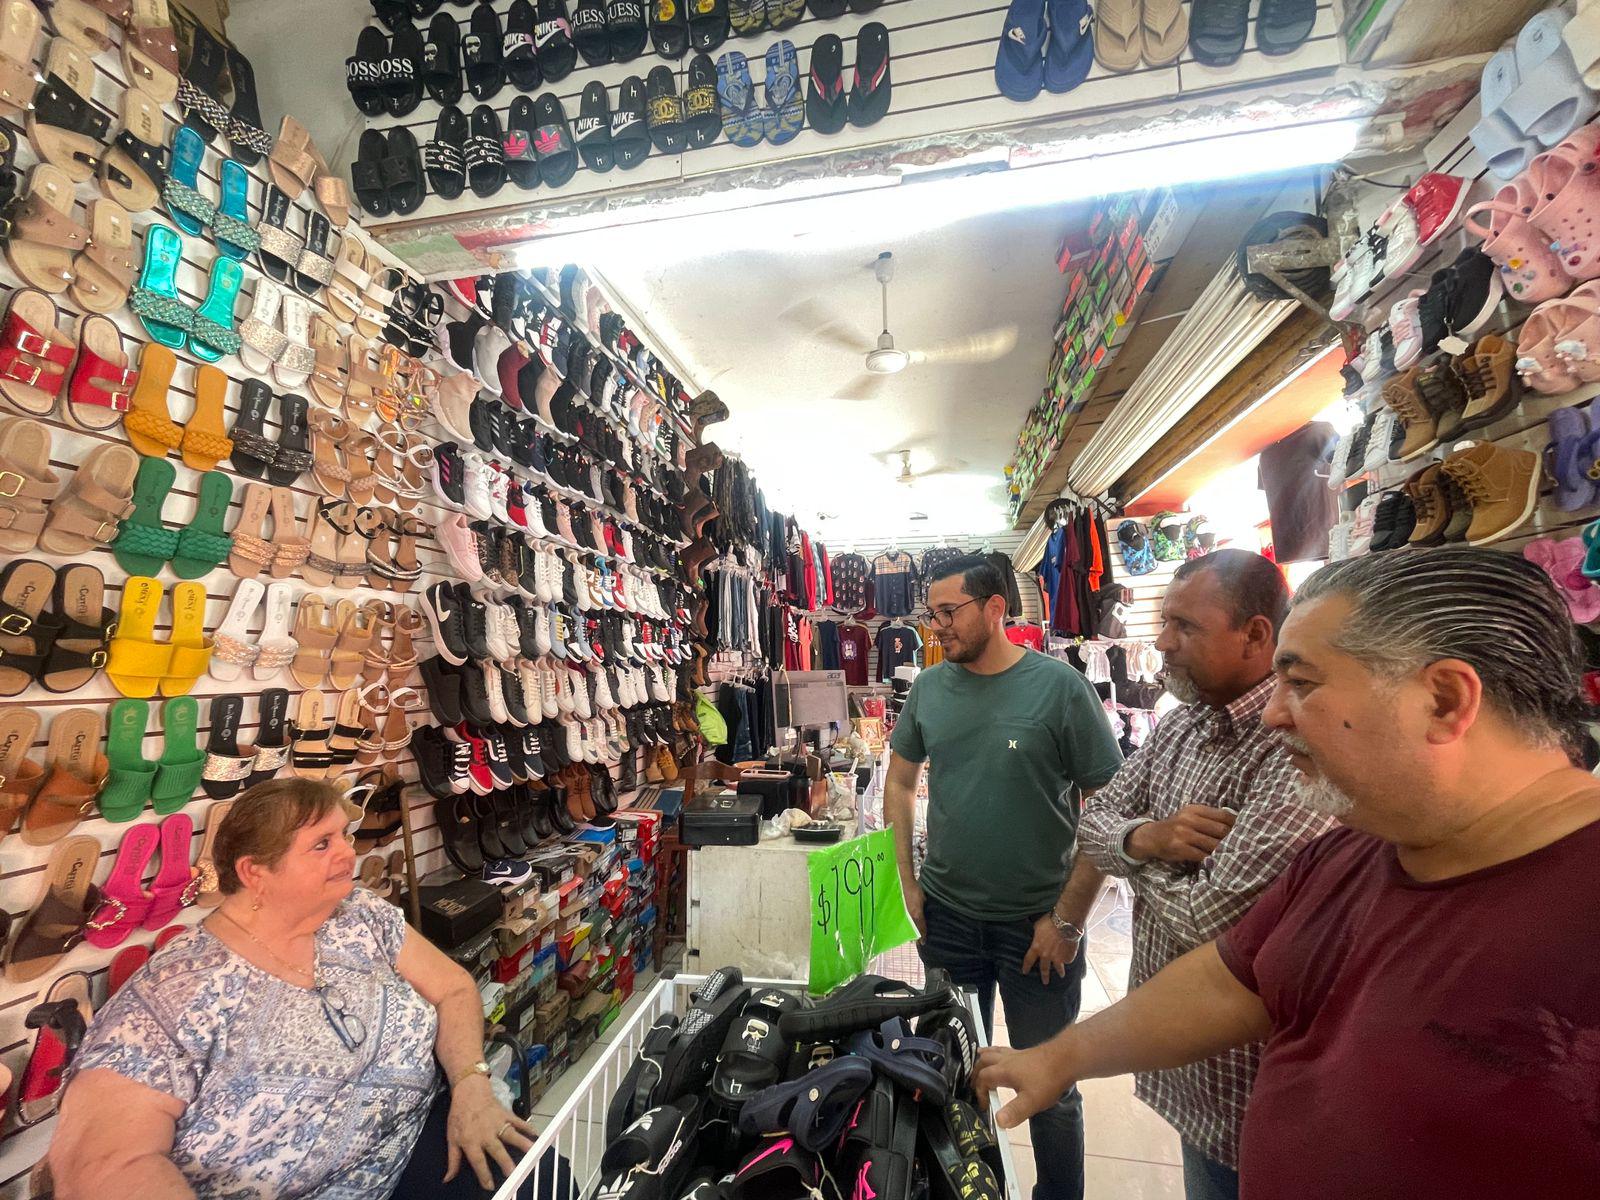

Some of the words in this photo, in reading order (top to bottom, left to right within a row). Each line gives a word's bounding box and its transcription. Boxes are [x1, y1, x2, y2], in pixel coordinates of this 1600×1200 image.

[535, 20, 557, 36] NIKE
[503, 32, 525, 48] NIKE
[378, 58, 414, 74] OSS
[578, 118, 600, 130] NIKE
[613, 112, 635, 127] NIKE
